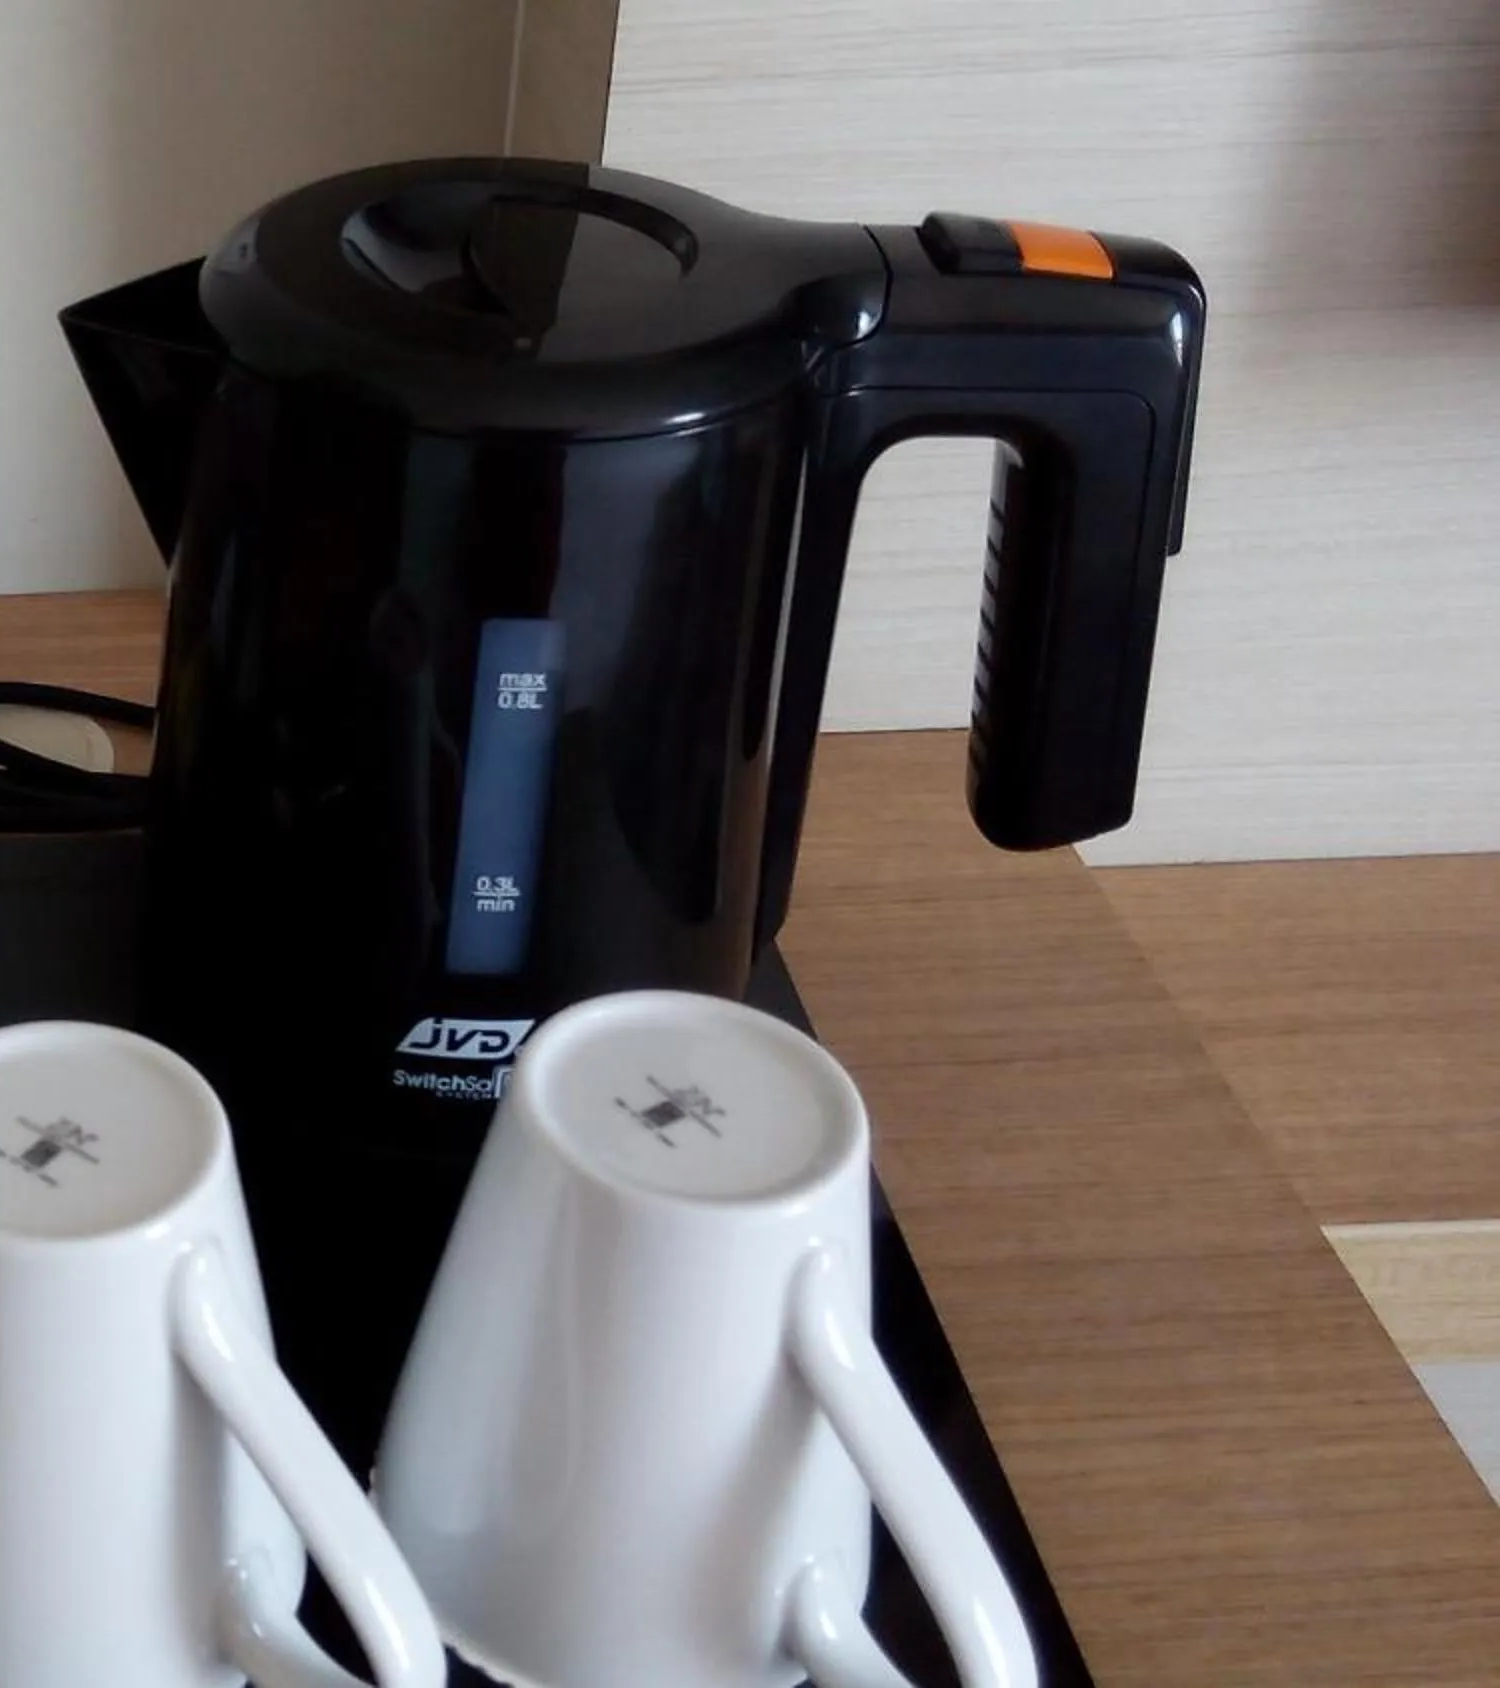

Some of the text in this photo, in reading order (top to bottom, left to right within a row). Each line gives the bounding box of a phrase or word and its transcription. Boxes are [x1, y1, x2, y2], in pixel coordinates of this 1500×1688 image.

[499, 673, 546, 688] max
[498, 691, 543, 709] 0.8L
[477, 875, 517, 891] 0.3L
[477, 897, 515, 912] min
